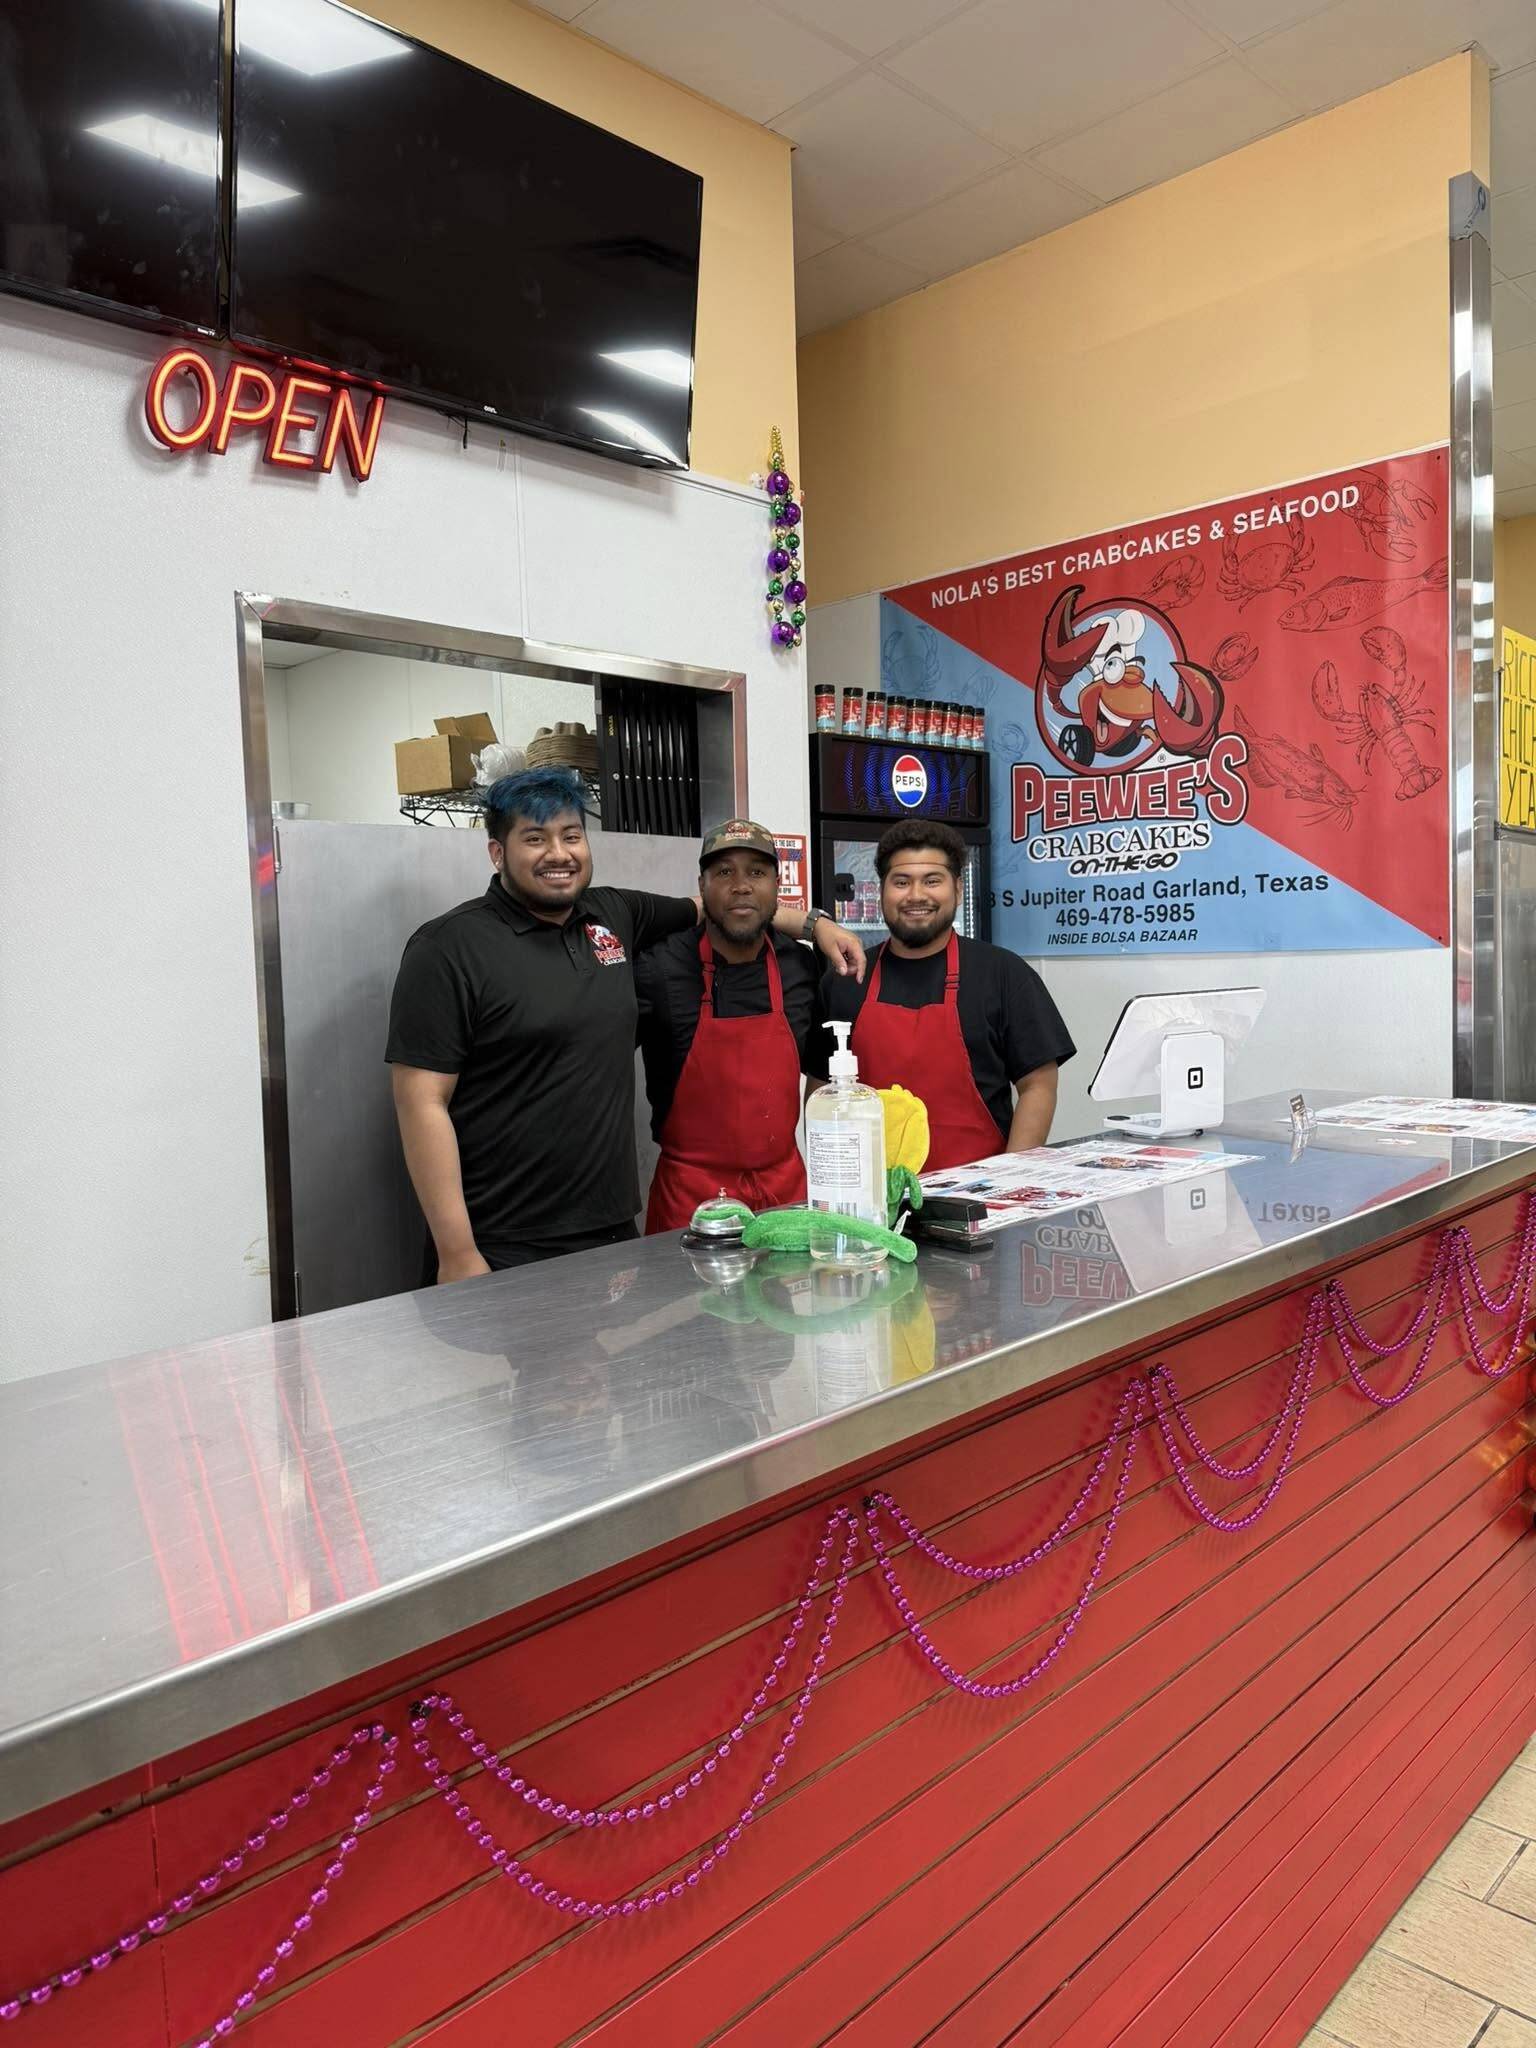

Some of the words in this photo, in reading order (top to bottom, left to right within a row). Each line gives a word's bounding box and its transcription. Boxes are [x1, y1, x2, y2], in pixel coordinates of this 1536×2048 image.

[145, 347, 386, 482] OPEN
[931, 576, 999, 609] NOLA'S
[1005, 560, 1056, 590] BEST
[1062, 524, 1201, 575] CRABCAKES
[1209, 519, 1224, 541] &
[1233, 485, 1360, 534] SEAFOOD
[895, 775, 925, 788] PEPSI
[1011, 734, 1249, 844] PEEWEE'S
[1029, 823, 1211, 860] CRABCAKES
[1002, 890, 1014, 907] S
[1020, 887, 1086, 910] Jupiter
[1093, 882, 1145, 902] Road
[1153, 875, 1247, 899] Garland,
[1255, 873, 1329, 893] Texas
[1056, 903, 1195, 927] 469-478-5985
[1047, 932, 1089, 945] INSIDE
[1091, 931, 1136, 944] BOLSA
[1140, 929, 1198, 942] BAZAAR
